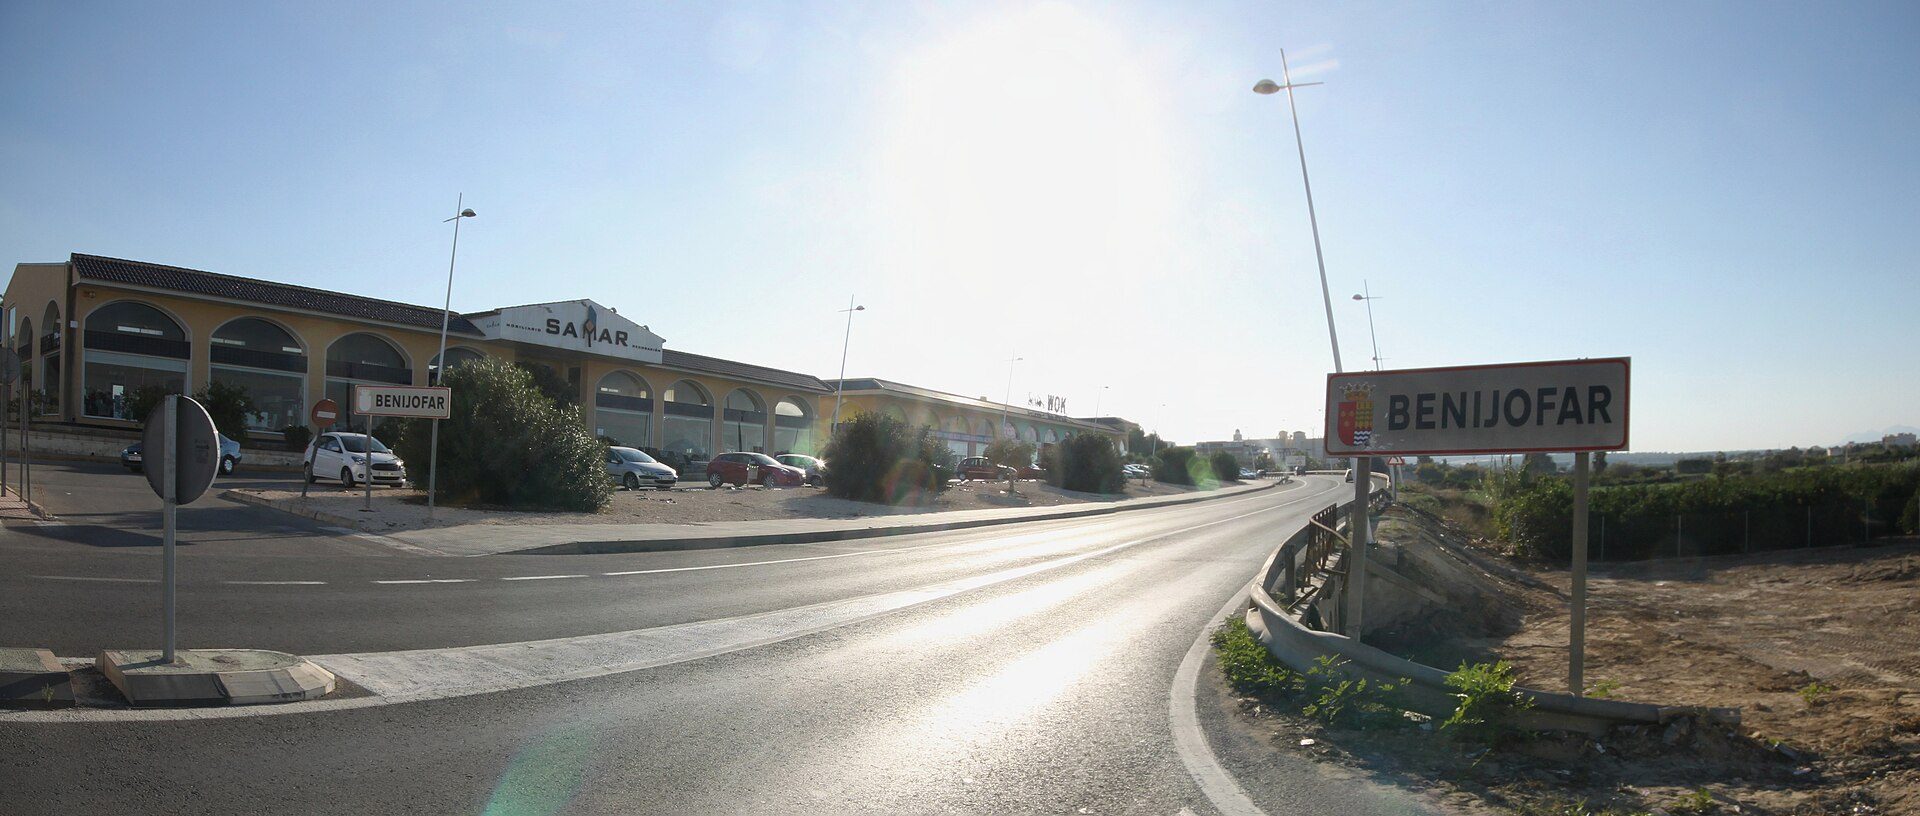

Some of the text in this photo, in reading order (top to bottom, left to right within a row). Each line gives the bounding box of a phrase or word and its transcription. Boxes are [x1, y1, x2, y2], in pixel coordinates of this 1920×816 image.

[545, 318, 629, 347] SAMAR
[375, 394, 445, 410] BENIJOFAR
[1047, 394, 1067, 414] WOK
[1388, 384, 1613, 431] BENIJOFAR
